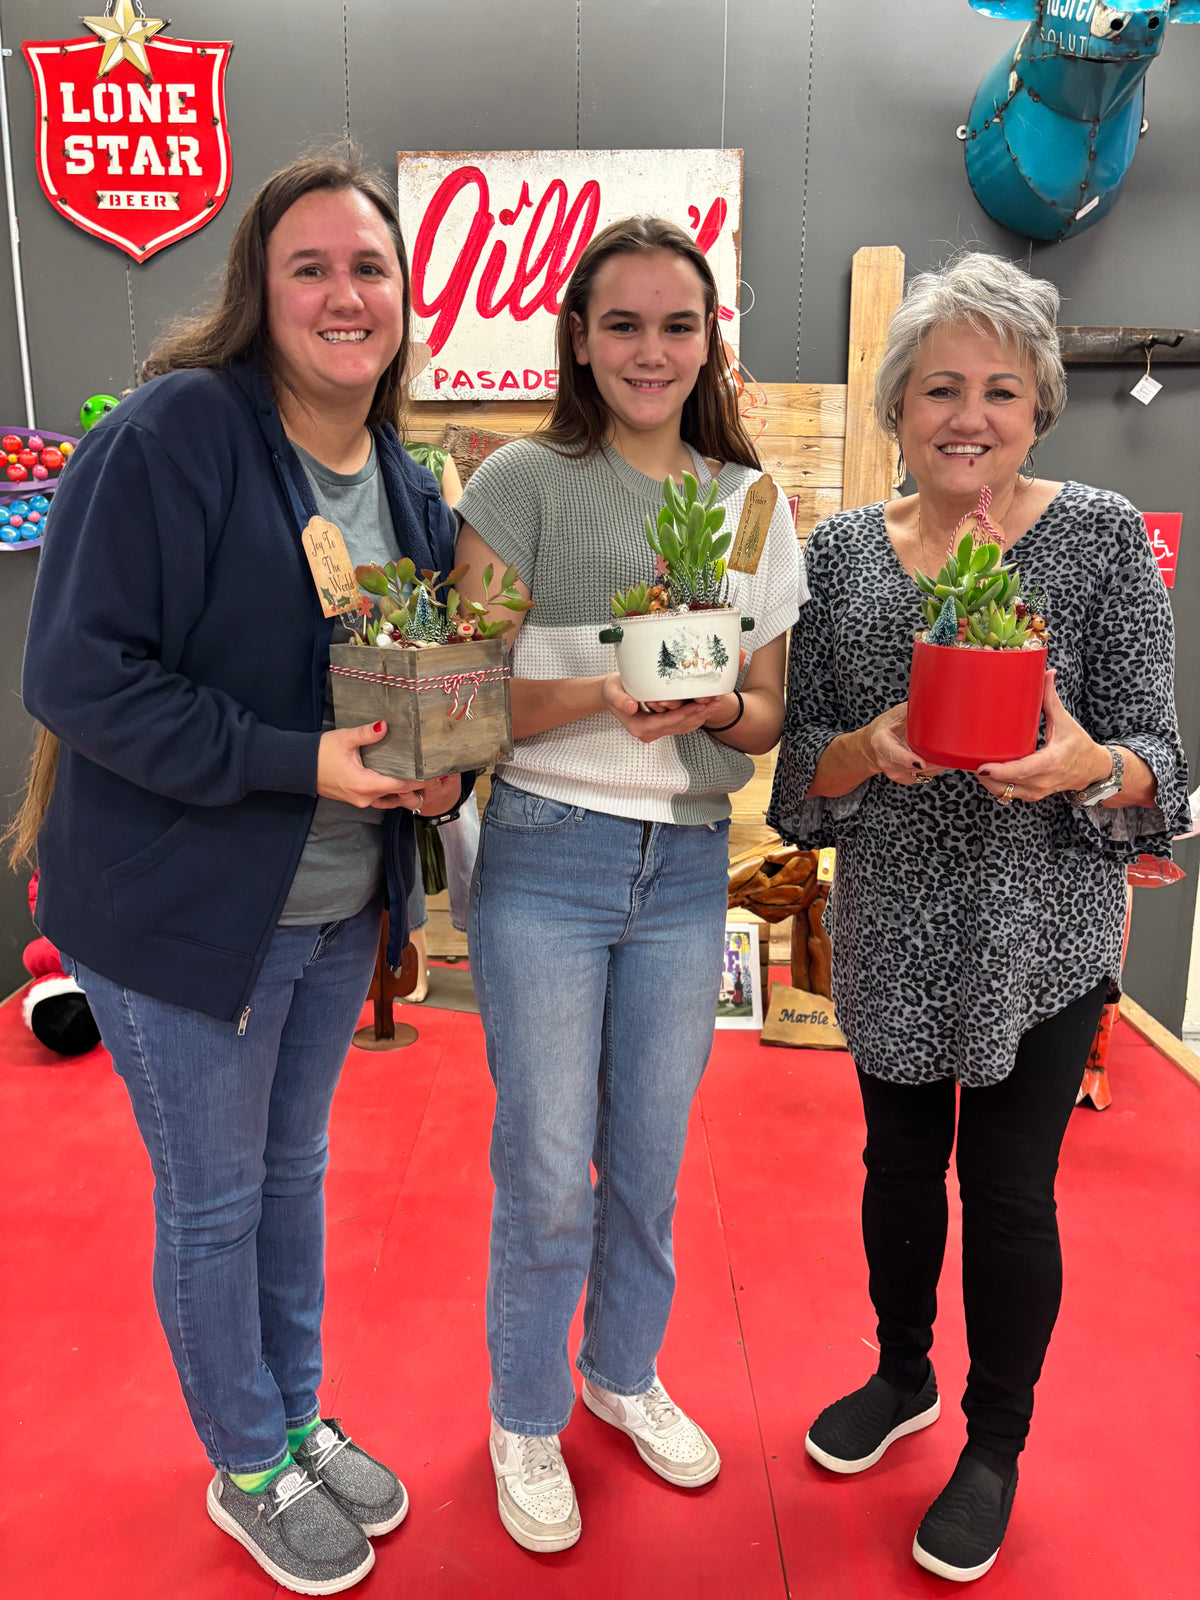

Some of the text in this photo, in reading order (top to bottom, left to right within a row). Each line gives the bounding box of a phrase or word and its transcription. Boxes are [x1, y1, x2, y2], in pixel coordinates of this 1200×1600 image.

[60, 82, 197, 123] LONE
[64, 135, 203, 176] STAR
[109, 194, 168, 208] BEER
[434, 368, 559, 391] PASADE
[309, 534, 325, 557] Joy
[322, 555, 341, 575] The
[328, 572, 355, 594] World
[778, 1008, 829, 1026] Marble
